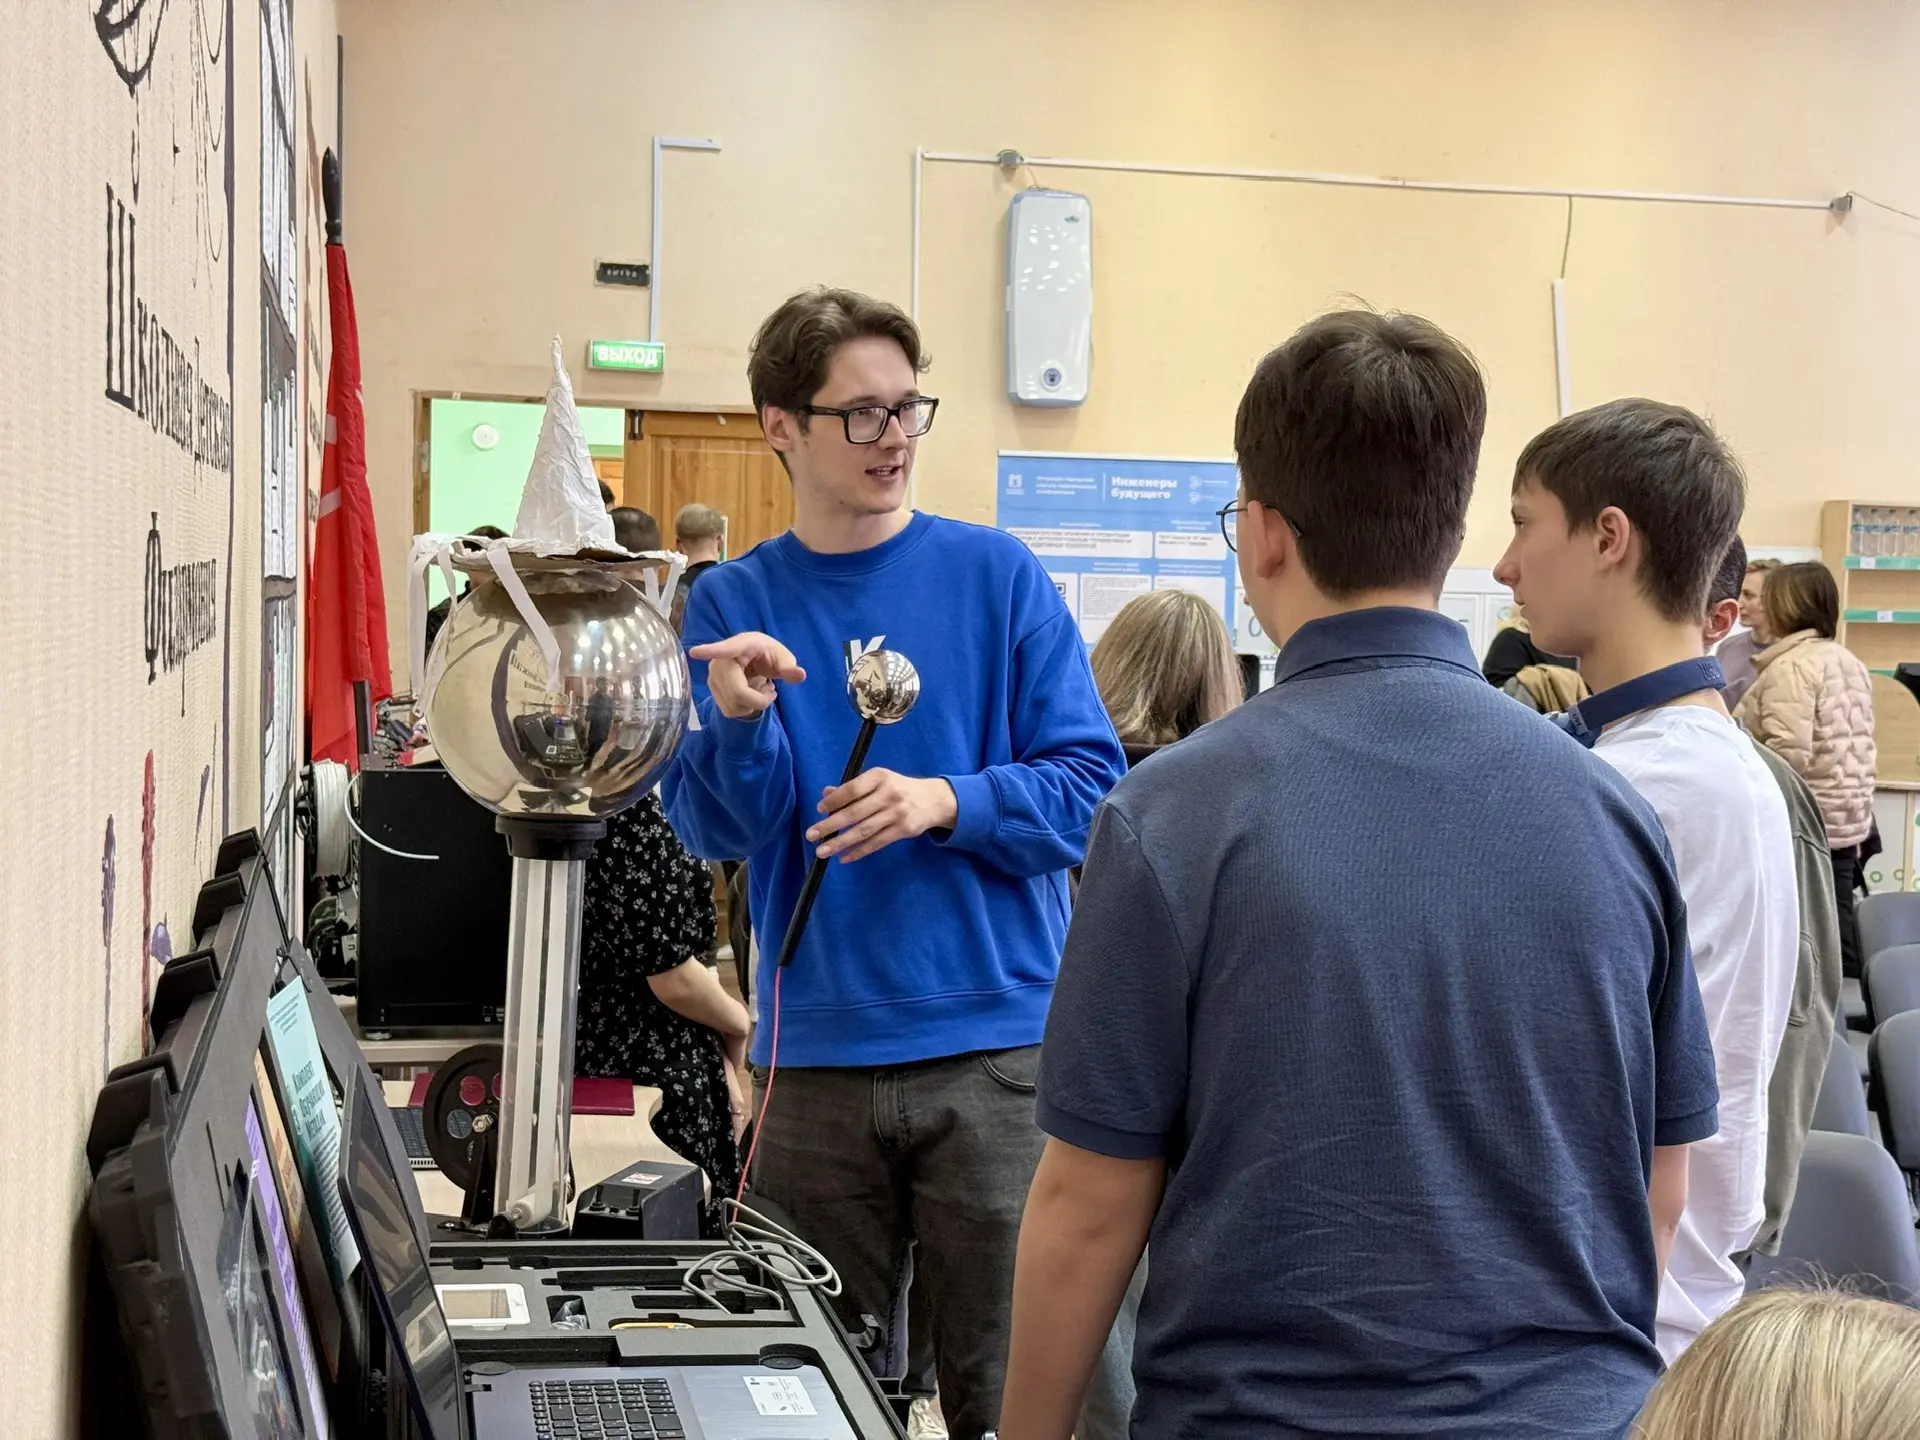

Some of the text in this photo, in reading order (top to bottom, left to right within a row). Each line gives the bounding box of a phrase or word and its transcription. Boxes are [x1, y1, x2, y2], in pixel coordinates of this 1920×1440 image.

[597, 345, 659, 368] ВЫХОД
[1111, 476, 1177, 490] Инженеры
[1111, 487, 1171, 500] будущего
